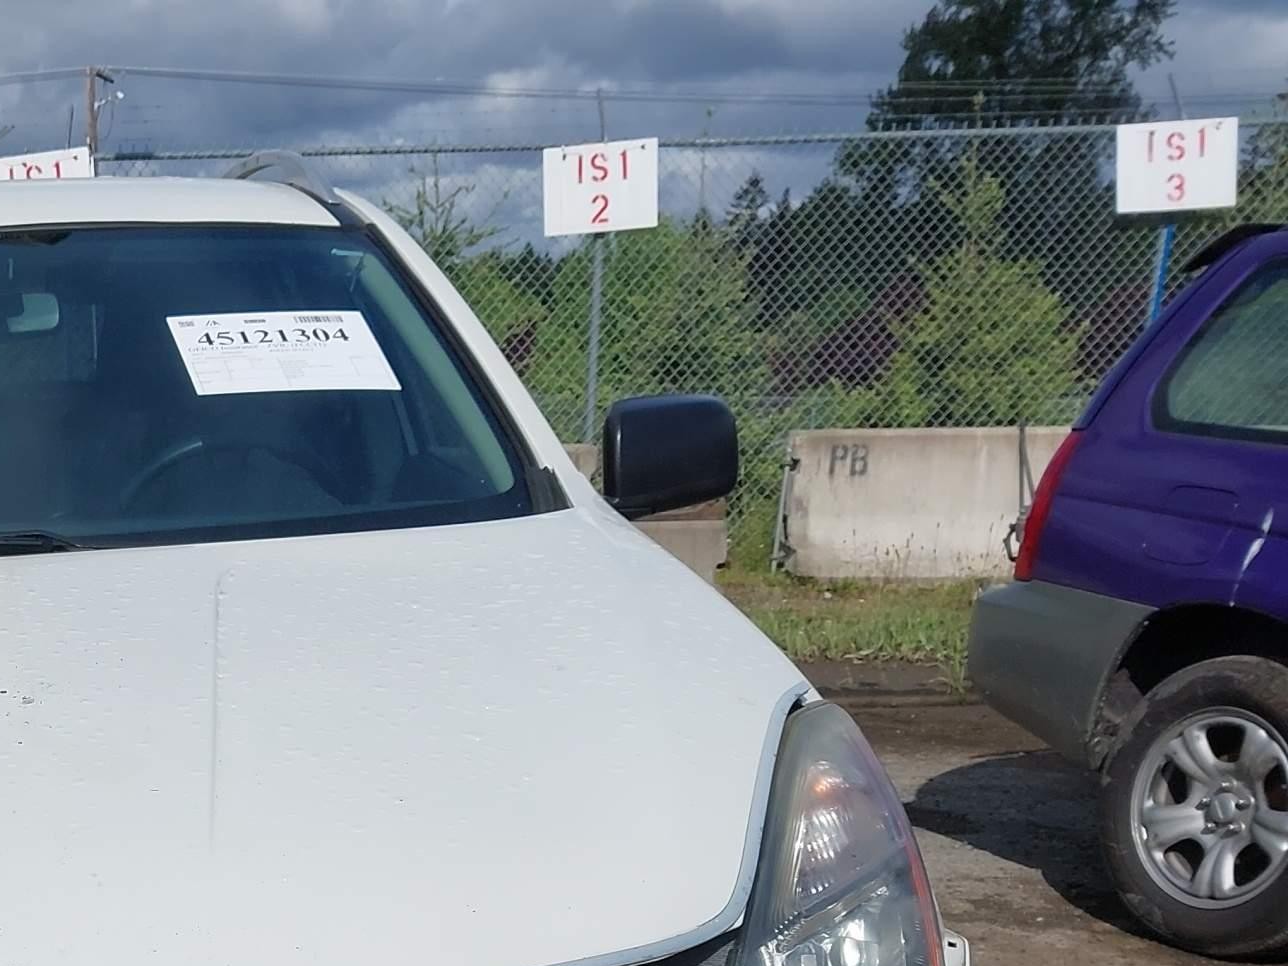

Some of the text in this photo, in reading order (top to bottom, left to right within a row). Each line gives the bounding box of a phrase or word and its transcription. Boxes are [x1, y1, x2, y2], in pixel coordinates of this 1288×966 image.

[1166, 173, 1185, 202] 3
[591, 194, 609, 224] 2
[197, 328, 350, 346] 45121304
[828, 443, 869, 476] PB
